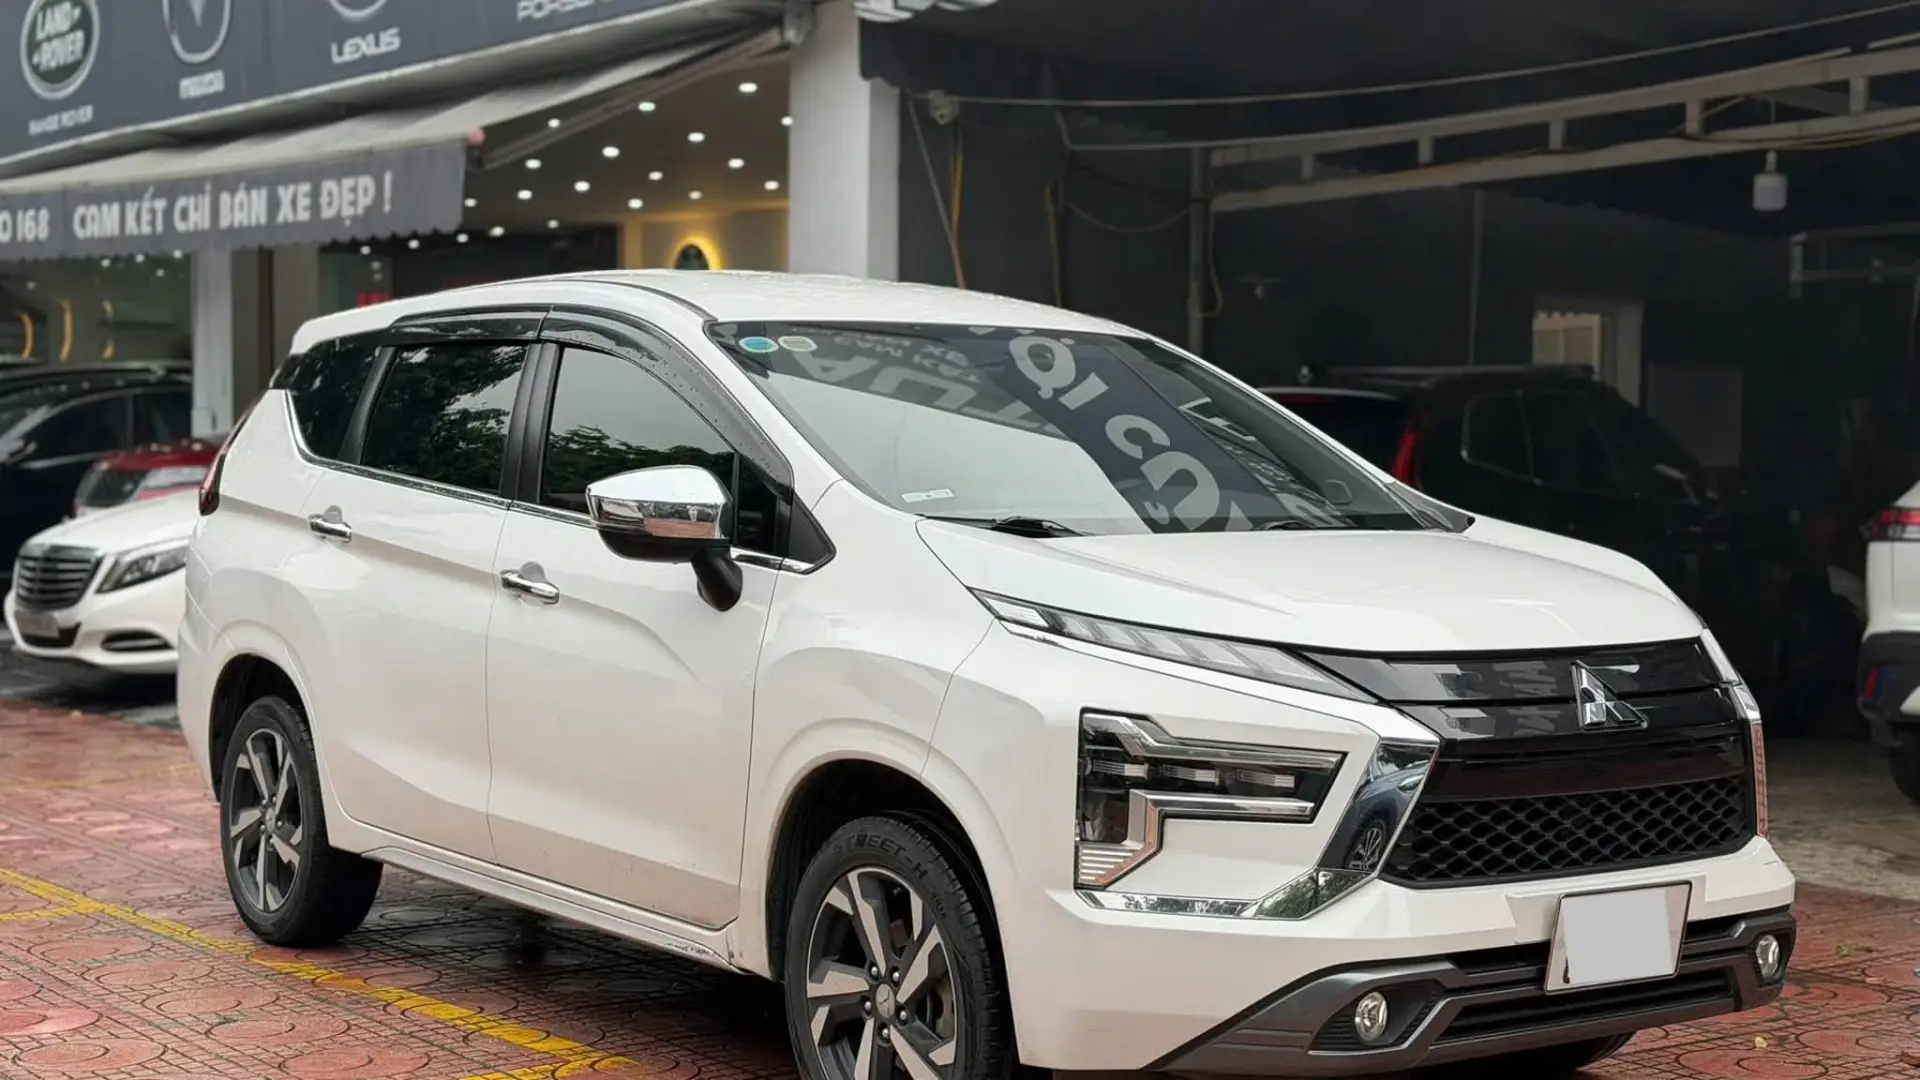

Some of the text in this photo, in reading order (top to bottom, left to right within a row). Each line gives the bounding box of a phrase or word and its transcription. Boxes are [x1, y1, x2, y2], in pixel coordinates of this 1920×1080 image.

[34, 1, 73, 42] LAND
[39, 29, 86, 72] ROVER
[330, 26, 402, 64] LEXUS
[16, 207, 50, 243] 168
[72, 201, 121, 240] CAM
[124, 186, 167, 236] KẾT
[173, 181, 211, 233] CHỈ
[218, 181, 268, 229] BÁN
[275, 181, 313, 224] XE
[318, 175, 377, 227] ĐẸP
